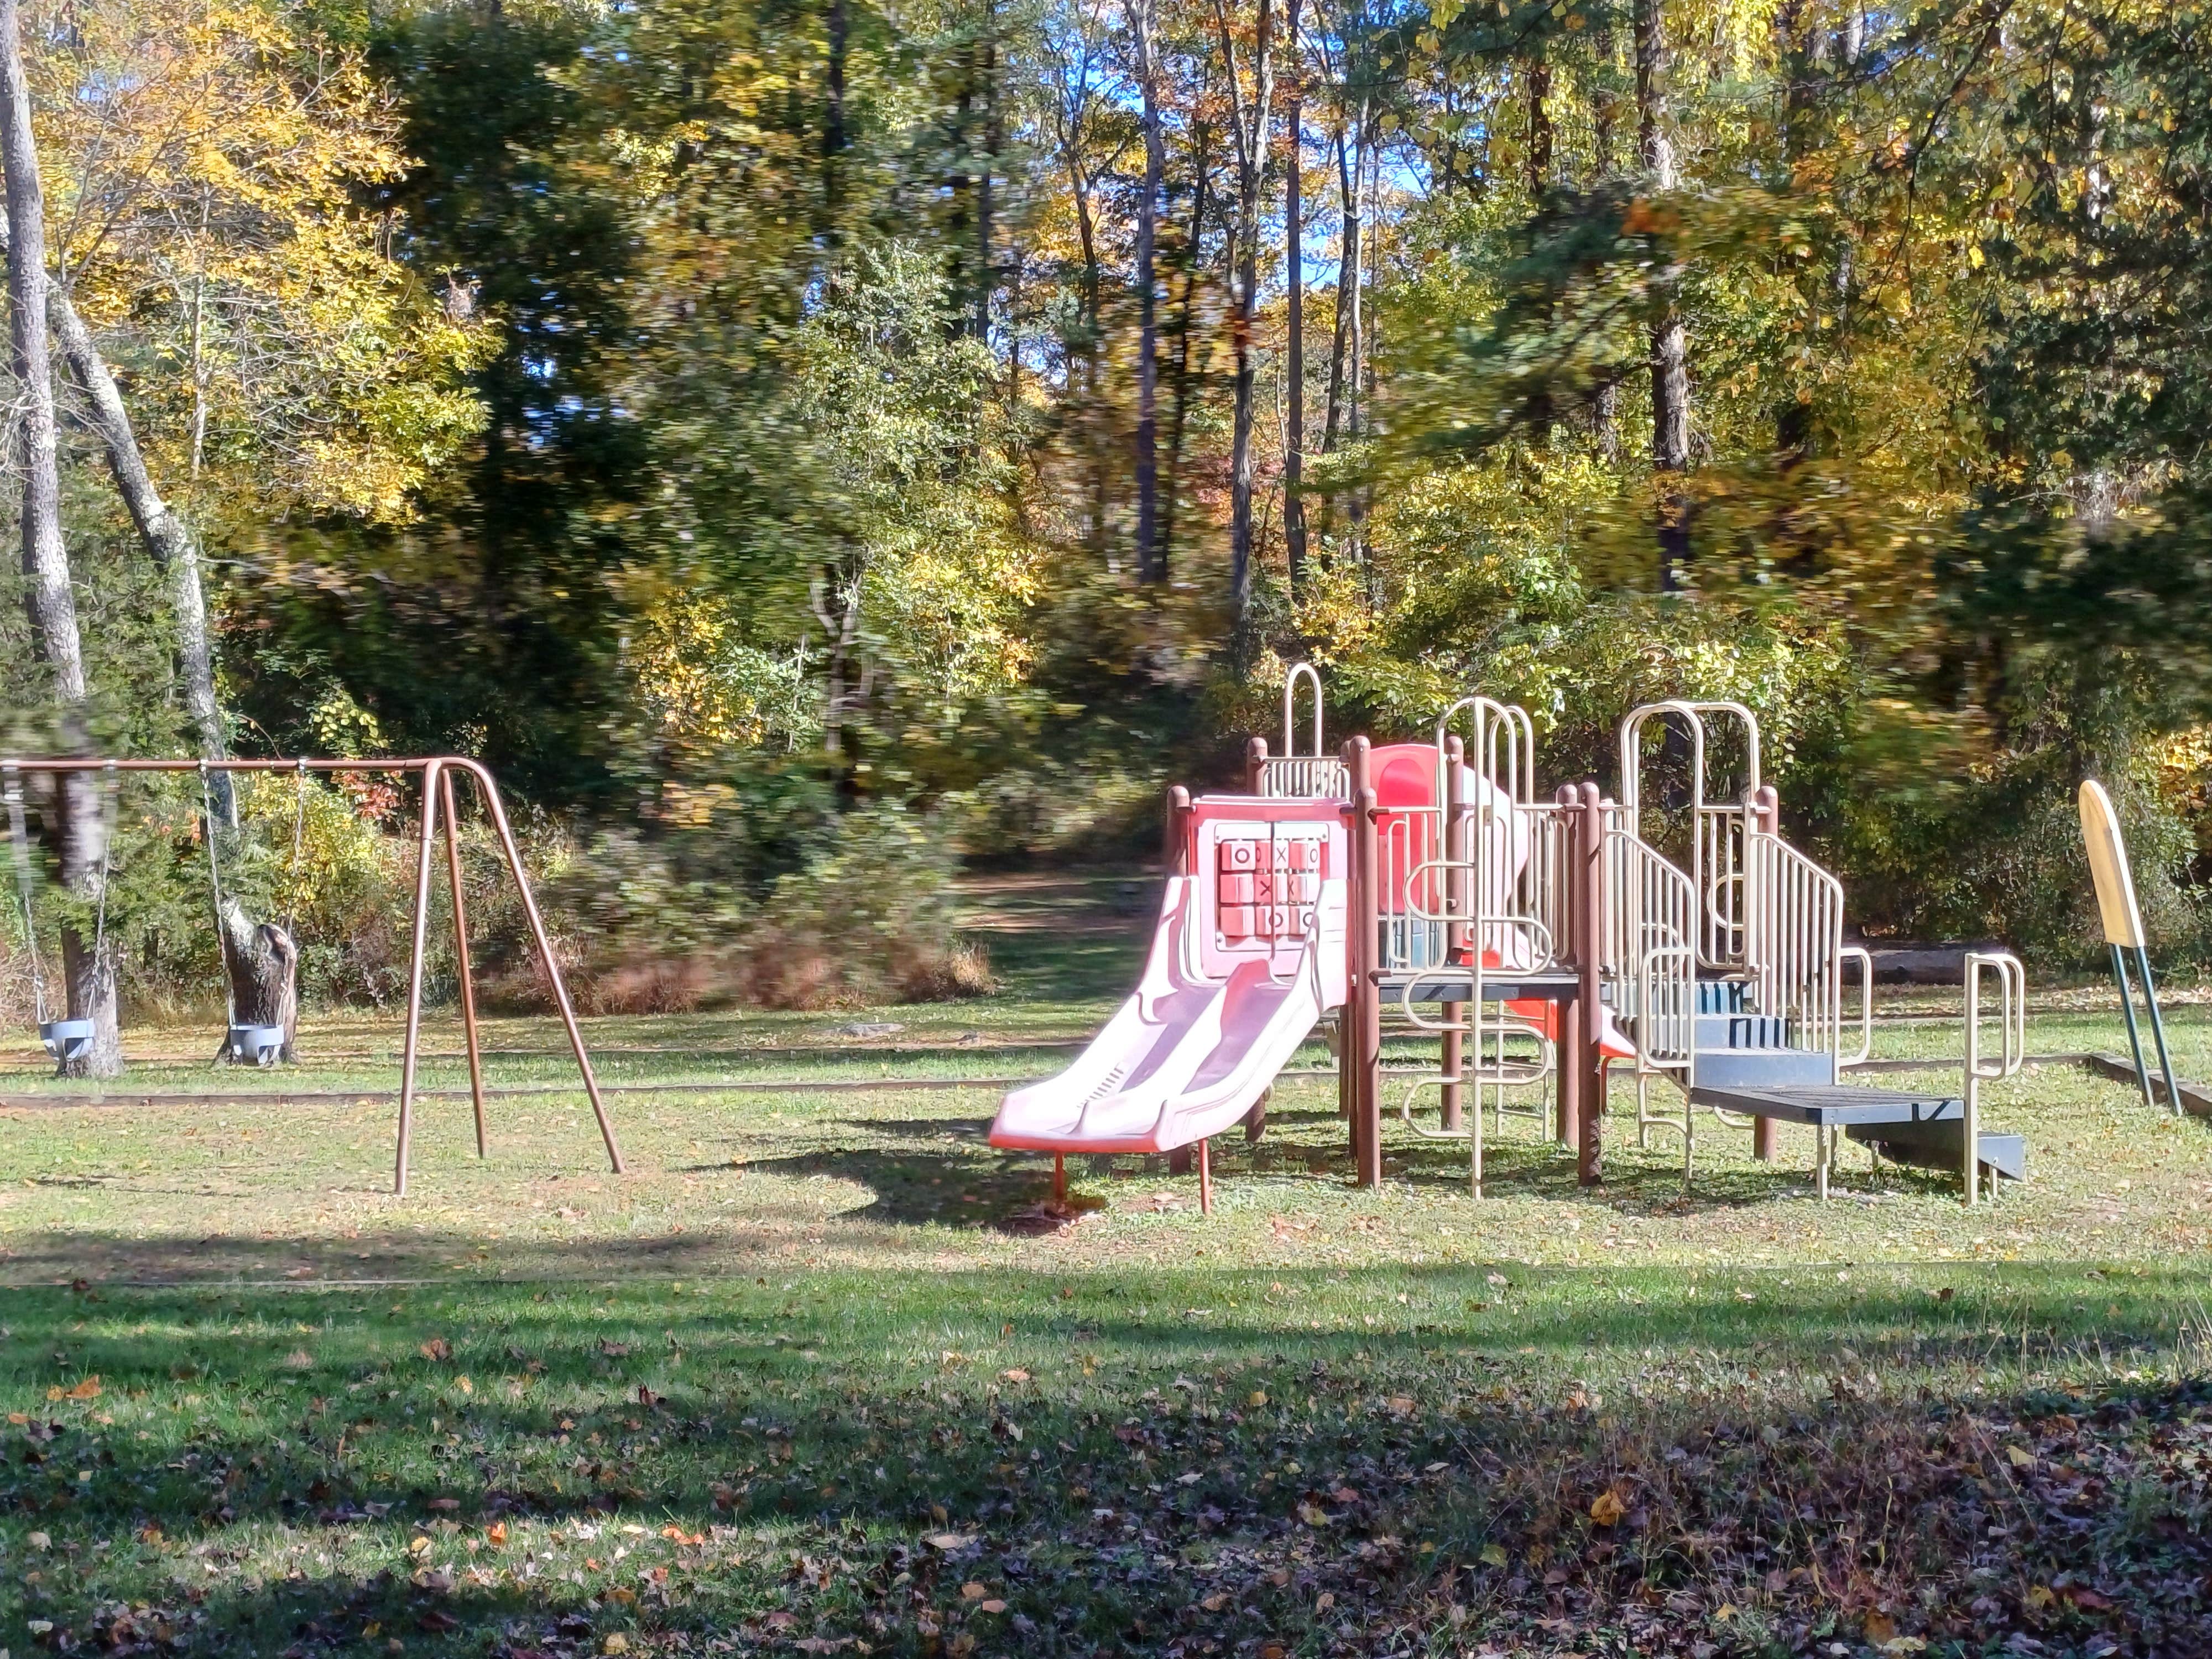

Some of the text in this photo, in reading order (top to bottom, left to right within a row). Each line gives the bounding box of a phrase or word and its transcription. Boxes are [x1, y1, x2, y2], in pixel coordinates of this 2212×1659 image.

[1235, 848, 1250, 863] O
[1276, 847, 1286, 863] X
[1310, 848, 1318, 863] O
[1269, 912, 1284, 927] O
